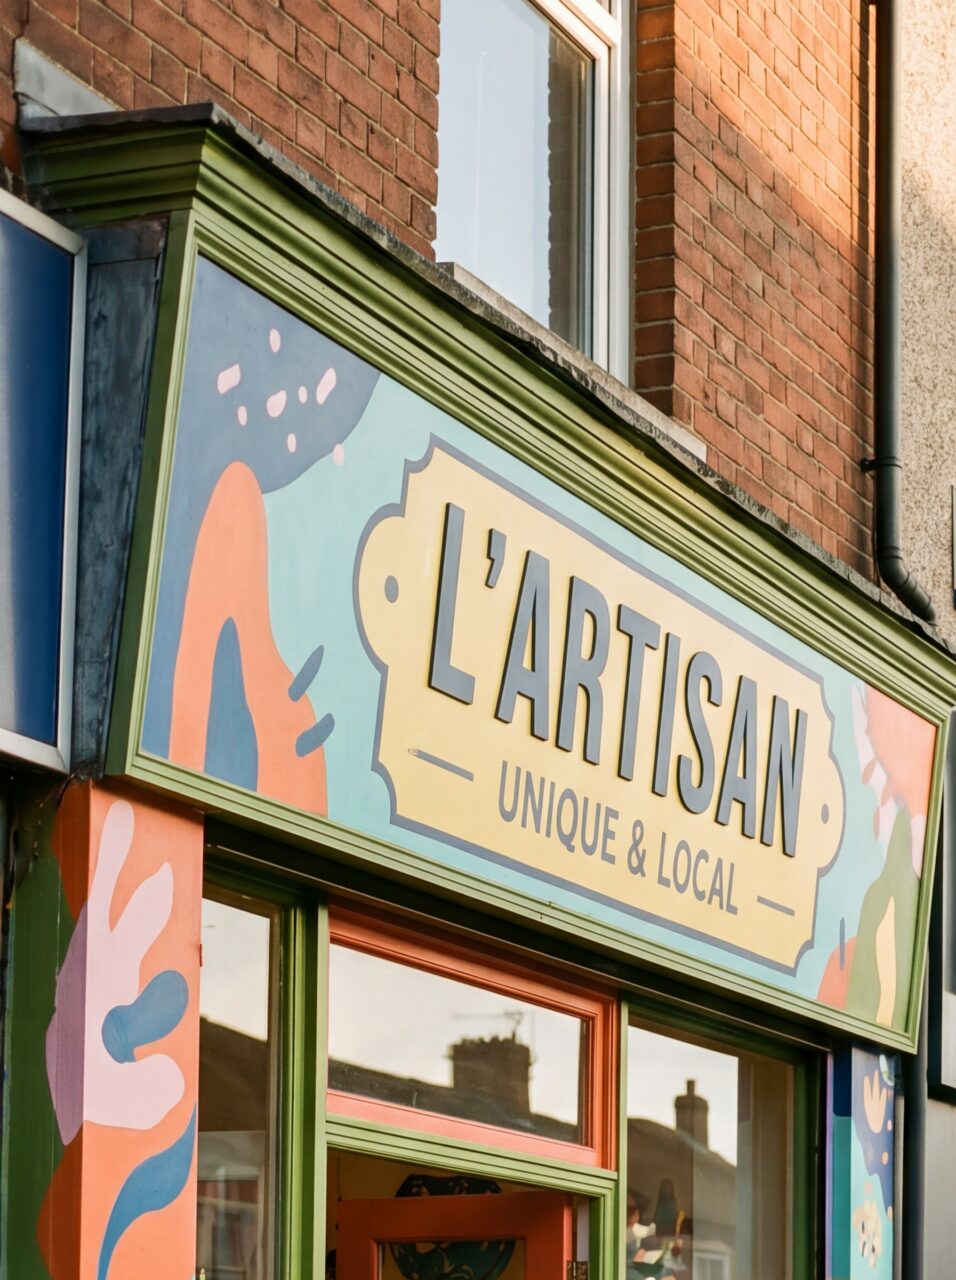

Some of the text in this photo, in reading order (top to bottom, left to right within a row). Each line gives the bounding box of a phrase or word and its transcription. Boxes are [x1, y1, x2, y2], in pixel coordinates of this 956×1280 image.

[427, 502, 809, 858] L’ARTISAN
[497, 759, 739, 916] UNIQUE & LOCAL
